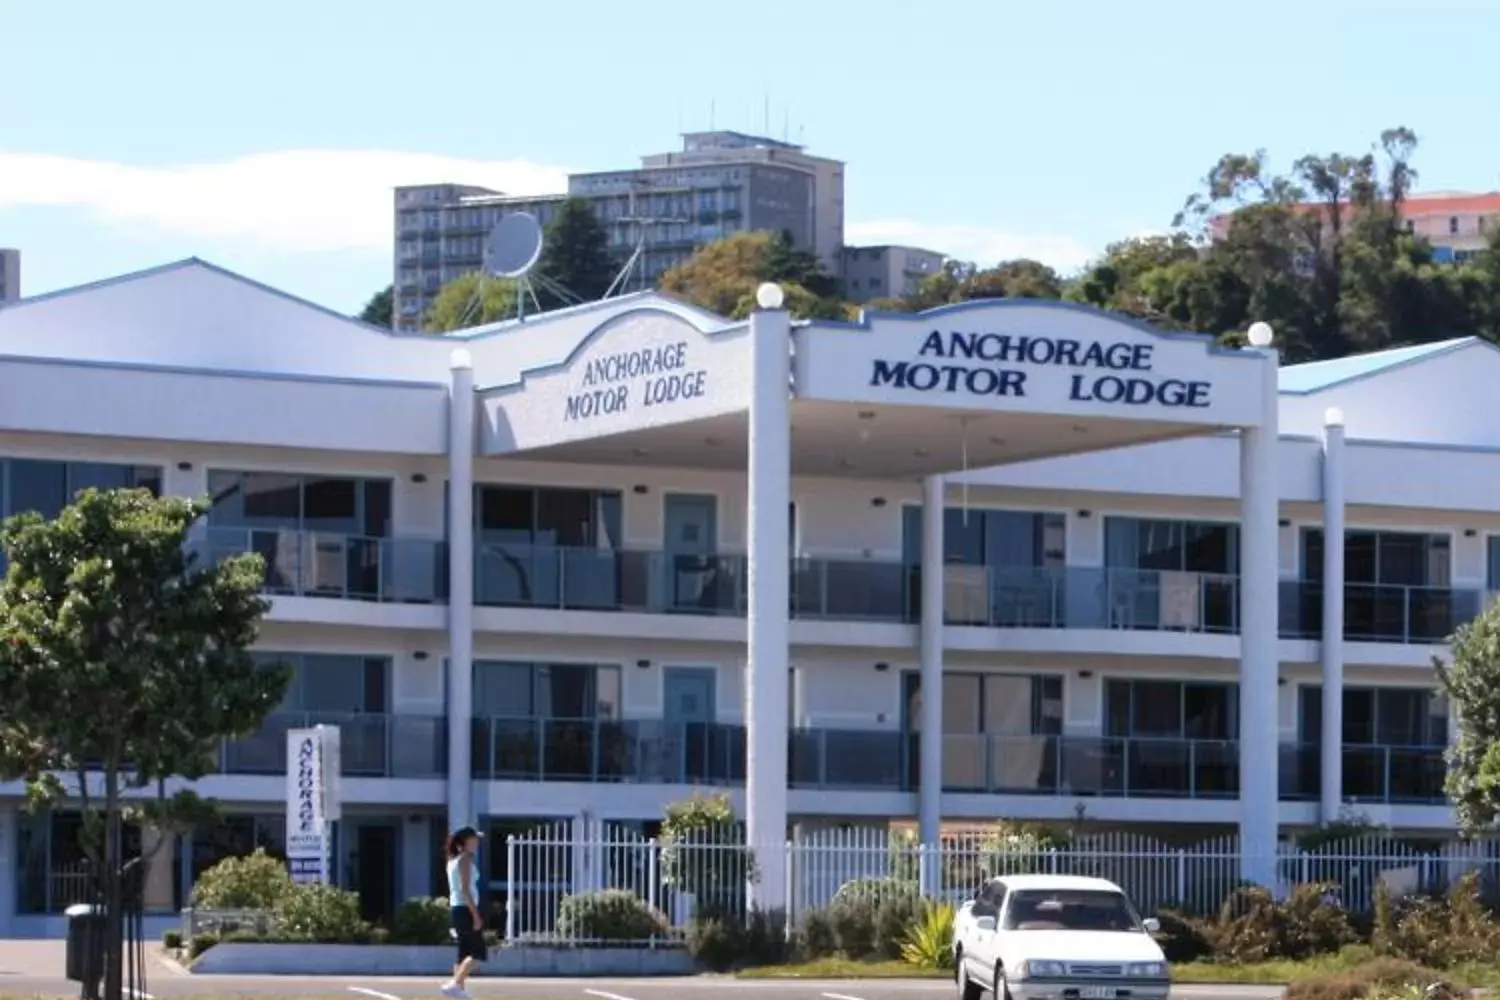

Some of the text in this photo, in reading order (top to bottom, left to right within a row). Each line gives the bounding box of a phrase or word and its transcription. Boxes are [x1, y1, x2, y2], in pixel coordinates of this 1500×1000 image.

[582, 341, 687, 387] ANCHORAGE
[918, 329, 1154, 370] ANCHORAGE
[564, 371, 707, 421] MOTOR LODGE
[869, 359, 1212, 408] MOTOR LODGE
